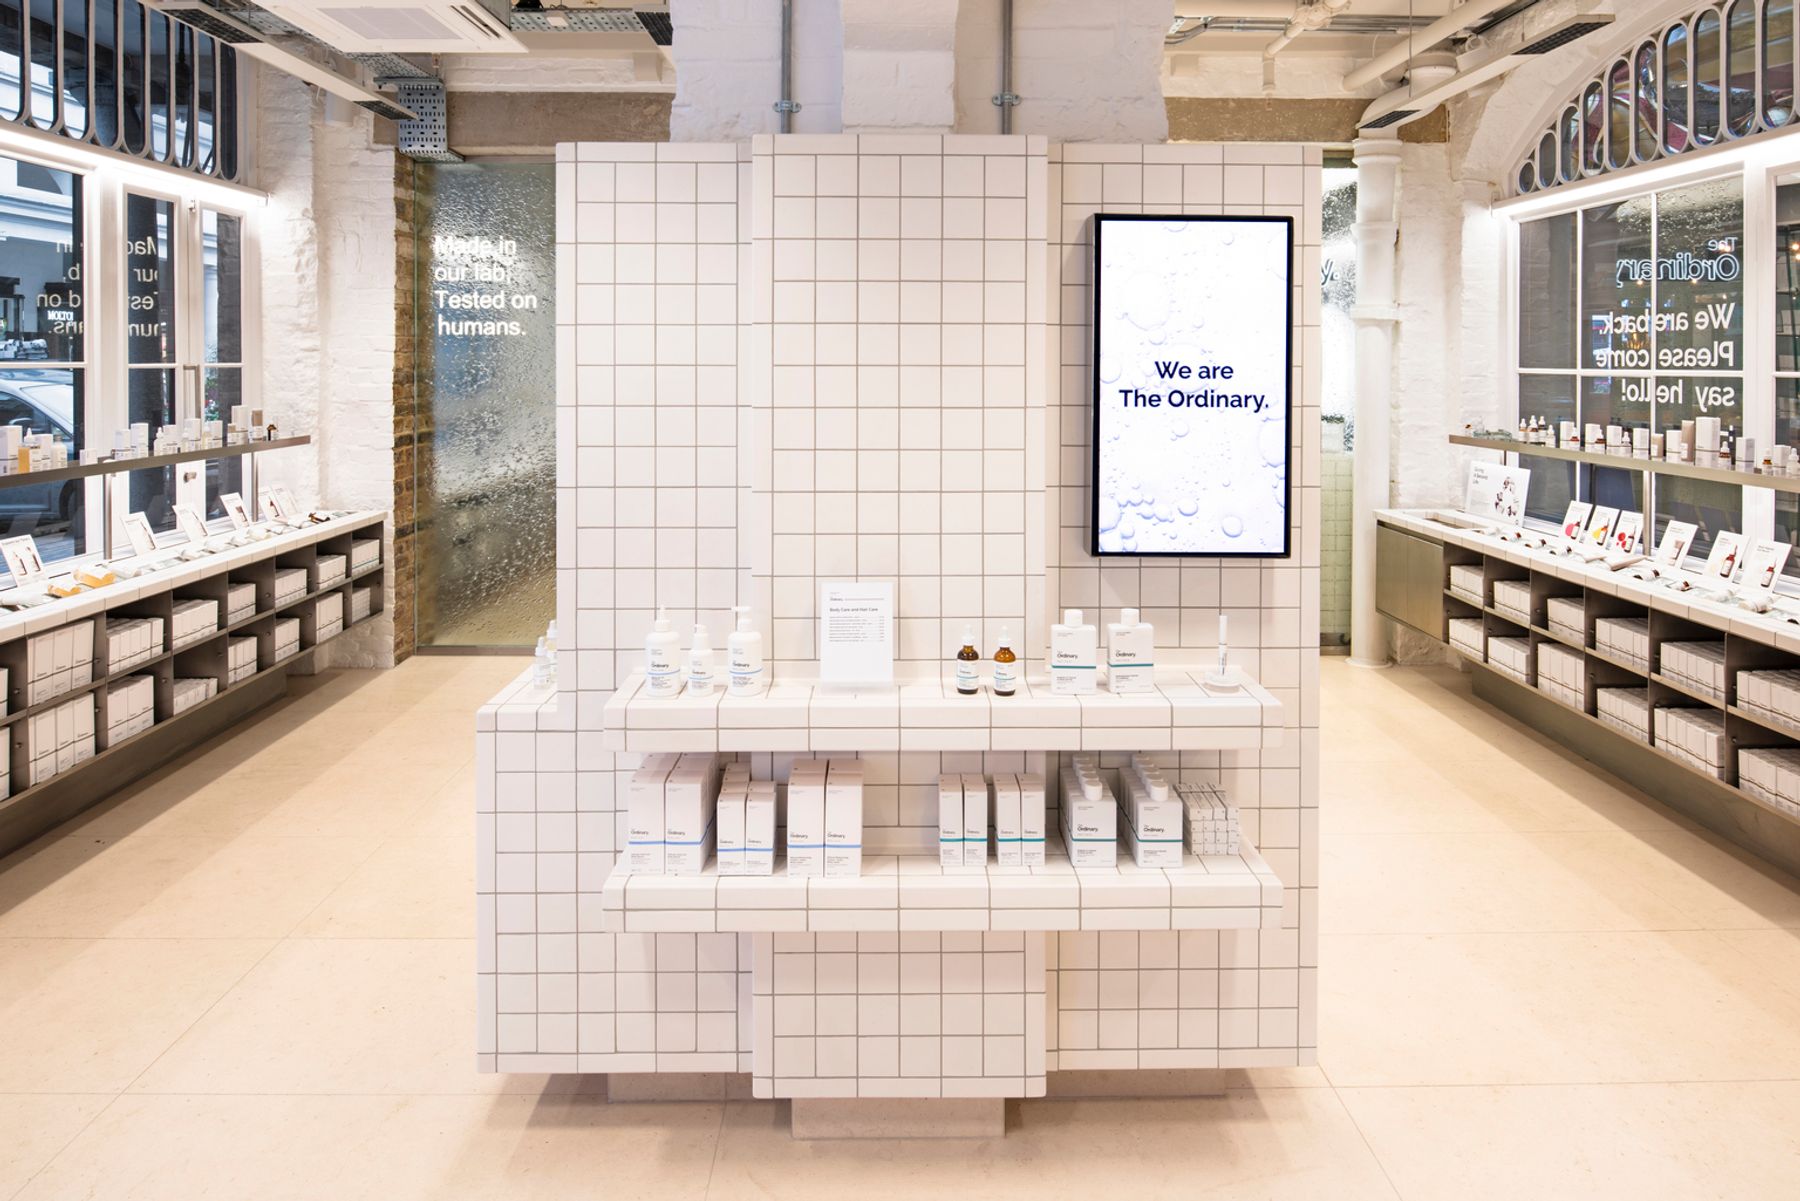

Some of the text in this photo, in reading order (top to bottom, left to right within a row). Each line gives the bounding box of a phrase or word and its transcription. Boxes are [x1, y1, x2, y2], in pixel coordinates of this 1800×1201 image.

[434, 235, 517, 254] Made in
[434, 266, 467, 282] our
[434, 290, 538, 309] Tested on
[437, 313, 526, 336] humans.
[1154, 361, 1234, 379] We are
[1118, 389, 1269, 413] The Ordinary.
